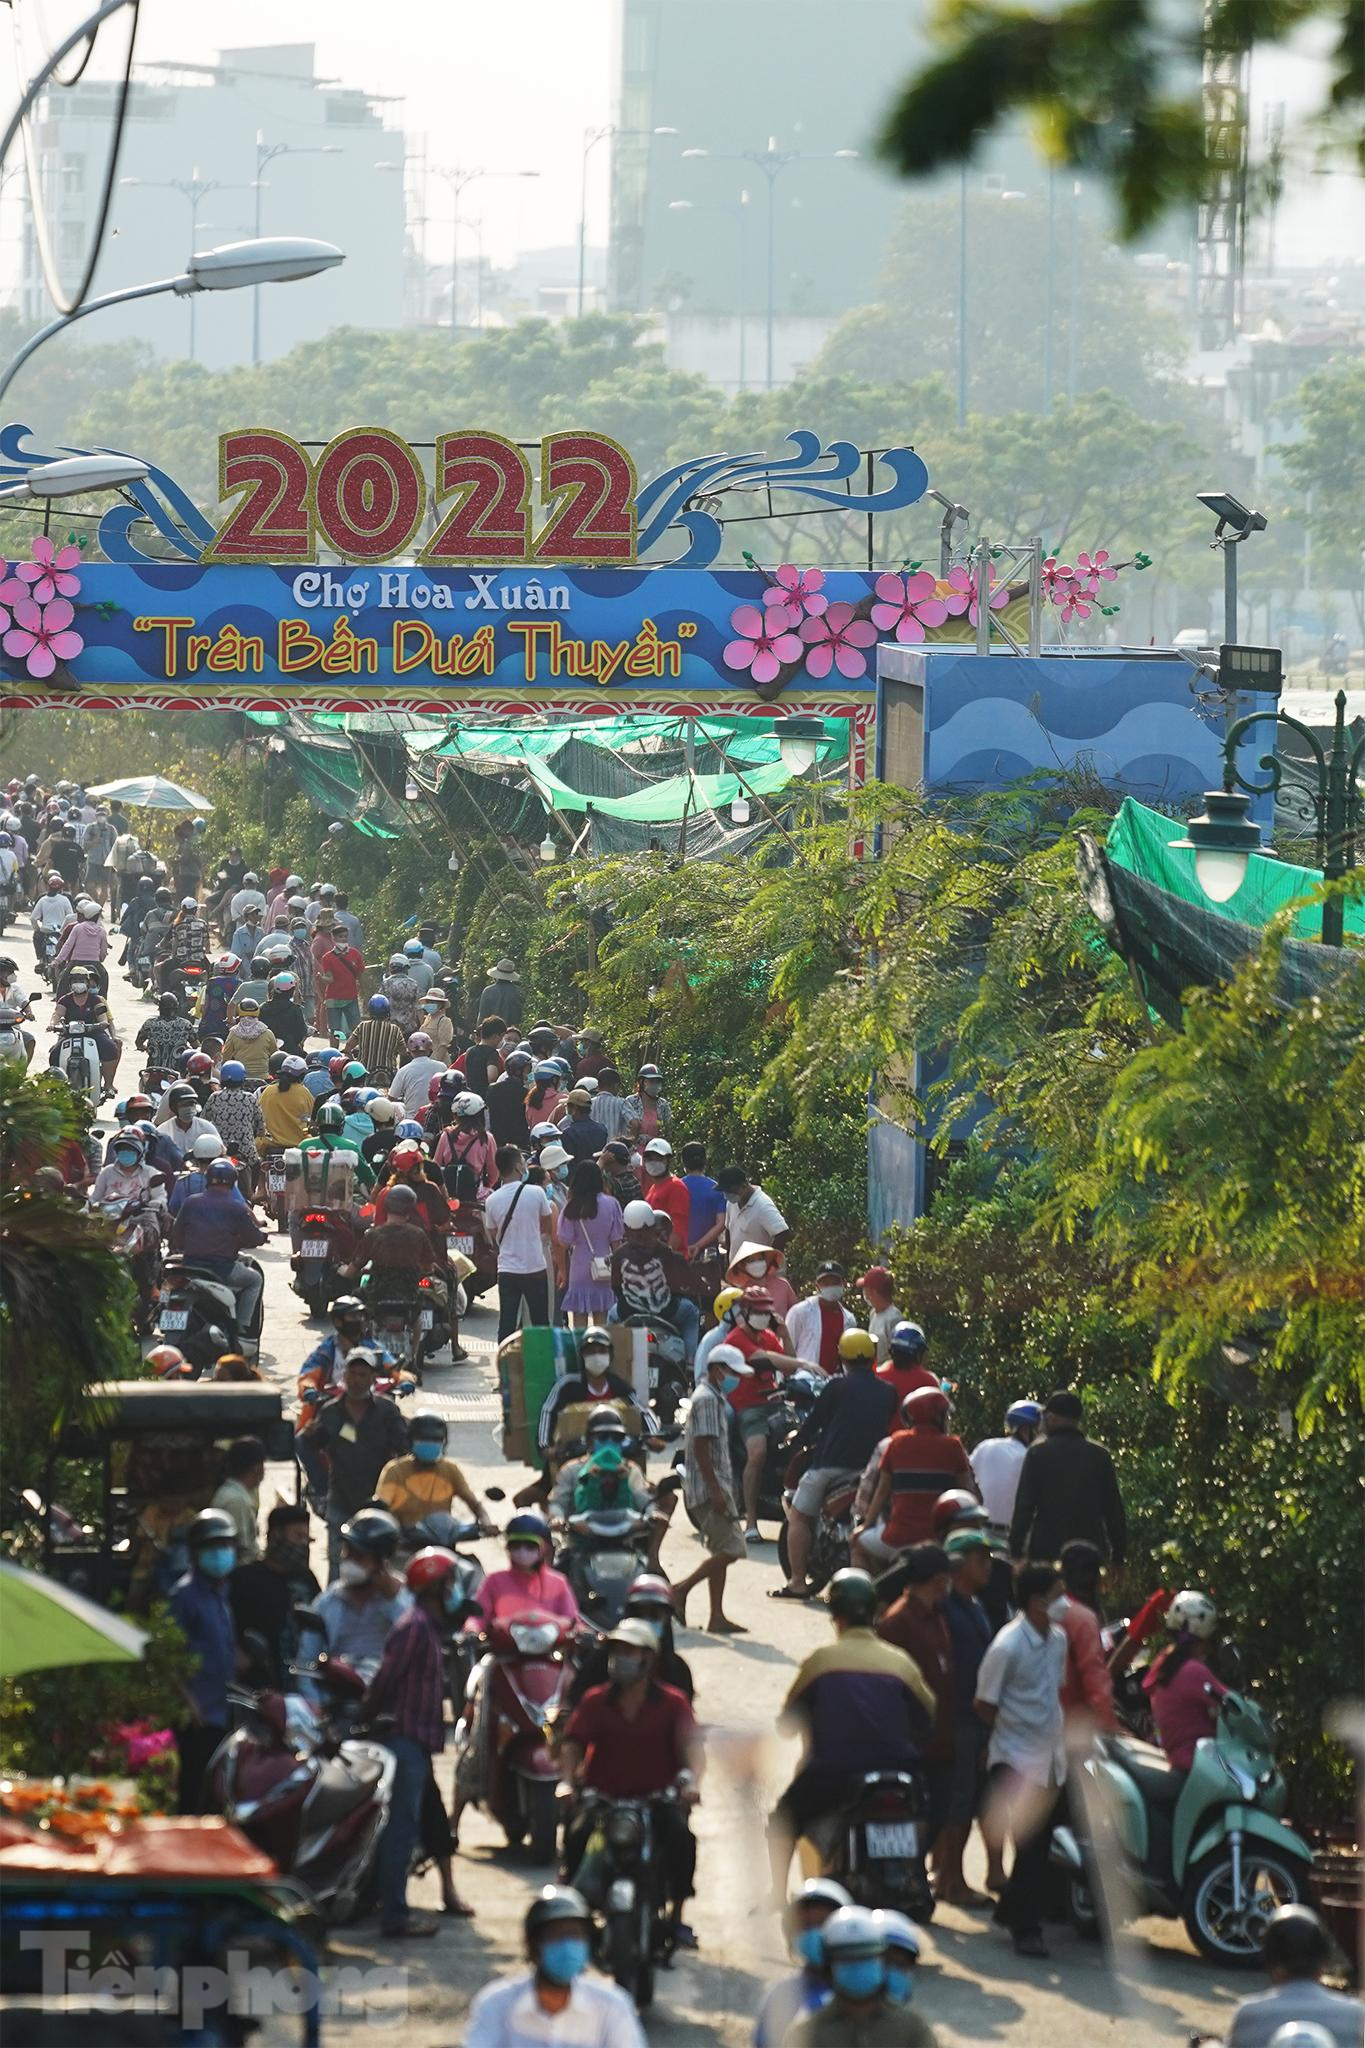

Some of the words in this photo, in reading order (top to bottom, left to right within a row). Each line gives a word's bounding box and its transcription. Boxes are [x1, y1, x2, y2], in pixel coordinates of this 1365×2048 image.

[200, 426, 639, 564] 2022
[292, 571, 370, 617] Chợ
[377, 573, 455, 609] Hoa
[464, 574, 572, 610] Xuân
[279, 615, 379, 674] Bến
[393, 619, 495, 676] Dưới
